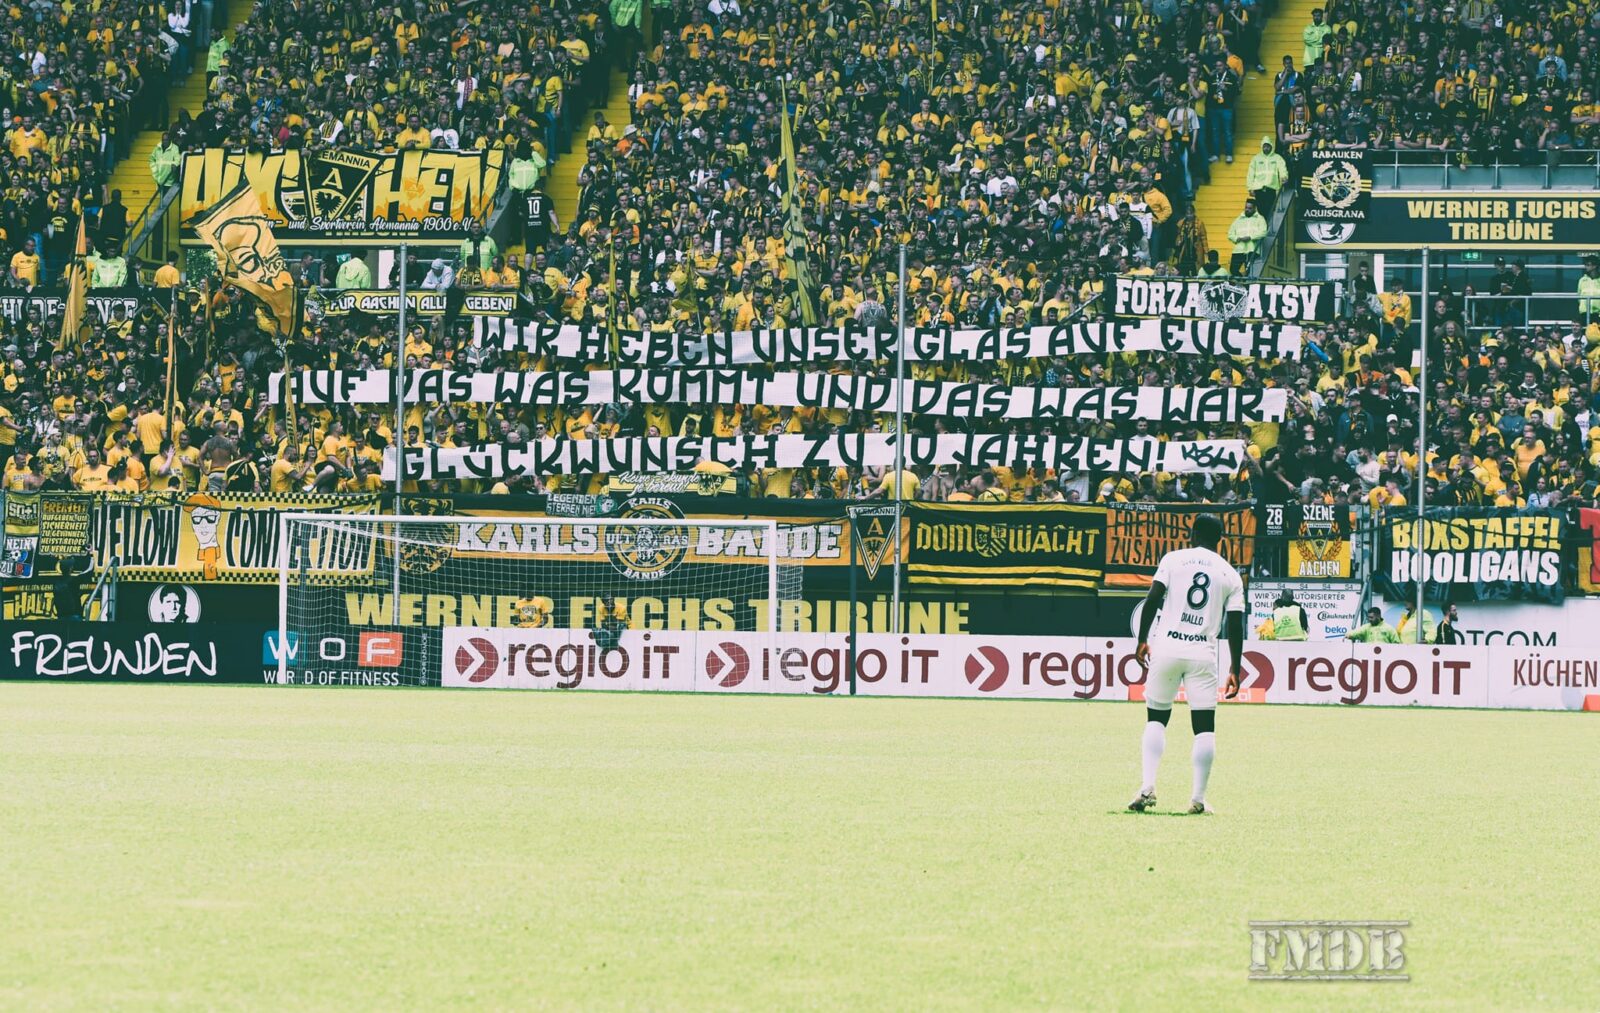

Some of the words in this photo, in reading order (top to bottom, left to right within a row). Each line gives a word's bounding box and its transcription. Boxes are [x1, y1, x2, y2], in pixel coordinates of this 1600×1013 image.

[1312, 150, 1363, 159] RABAUKEN
[527, 199, 540, 215] 10
[1304, 209, 1365, 219] AQUISGRANA
[1407, 200, 1509, 219] WERNER
[1515, 200, 1596, 219] FUCHS
[288, 216, 306, 231] und
[369, 216, 420, 231] Alemannia
[423, 216, 452, 232] 1900
[1448, 219, 1553, 241] TRIBÜNE
[465, 296, 512, 311] GEBEN!
[1115, 279, 1201, 317] FORZA
[1246, 284, 1320, 320] ATSV
[481, 317, 561, 358] WIR
[579, 324, 732, 368] HEBEN
[752, 327, 898, 362] UNSER
[913, 326, 1030, 361] GLAS
[1049, 318, 1142, 354] AUF
[278, 370, 367, 404] AUF
[388, 370, 472, 403] DAS
[494, 371, 590, 404] WAS
[612, 369, 775, 404] KOMMT
[796, 373, 891, 411] UND
[911, 380, 1013, 417] DAS
[1034, 386, 1138, 421] WAS
[402, 434, 778, 481] GLÜCKWUNSCH
[801, 433, 865, 467] ZU
[951, 433, 1167, 472] JAHREN!
[547, 493, 597, 504] LEGENDEN
[629, 498, 672, 509] KARLS
[1266, 509, 1283, 526] 28
[1302, 504, 1335, 520] SZENE
[94, 504, 181, 568] YELLOW
[456, 522, 599, 555] KARLS
[695, 524, 842, 558] BANDE
[663, 534, 688, 545] RAS
[916, 522, 974, 553] DOM
[1008, 524, 1101, 556] WACHT
[1391, 516, 1561, 550] BOXSTAFFEL
[624, 569, 668, 580] BANDE
[1299, 560, 1341, 577] AACHEN
[1391, 550, 1560, 586] HOOLIGANS
[1187, 571, 1210, 610] 8
[1180, 612, 1203, 626] DIALLO
[1167, 630, 1208, 642] POLYGON
[1325, 626, 1348, 634] beko
[10, 630, 217, 677] FREUNDEN
[507, 632, 630, 688] regio
[762, 635, 888, 693] regio
[901, 636, 939, 683] iT
[1022, 640, 1149, 699] regio
[1513, 653, 1598, 688] KÜCHEN
[318, 671, 337, 685] OF
[341, 671, 400, 687] FITNESS
[1287, 646, 1418, 704] regio
[1431, 647, 1471, 695] iT
